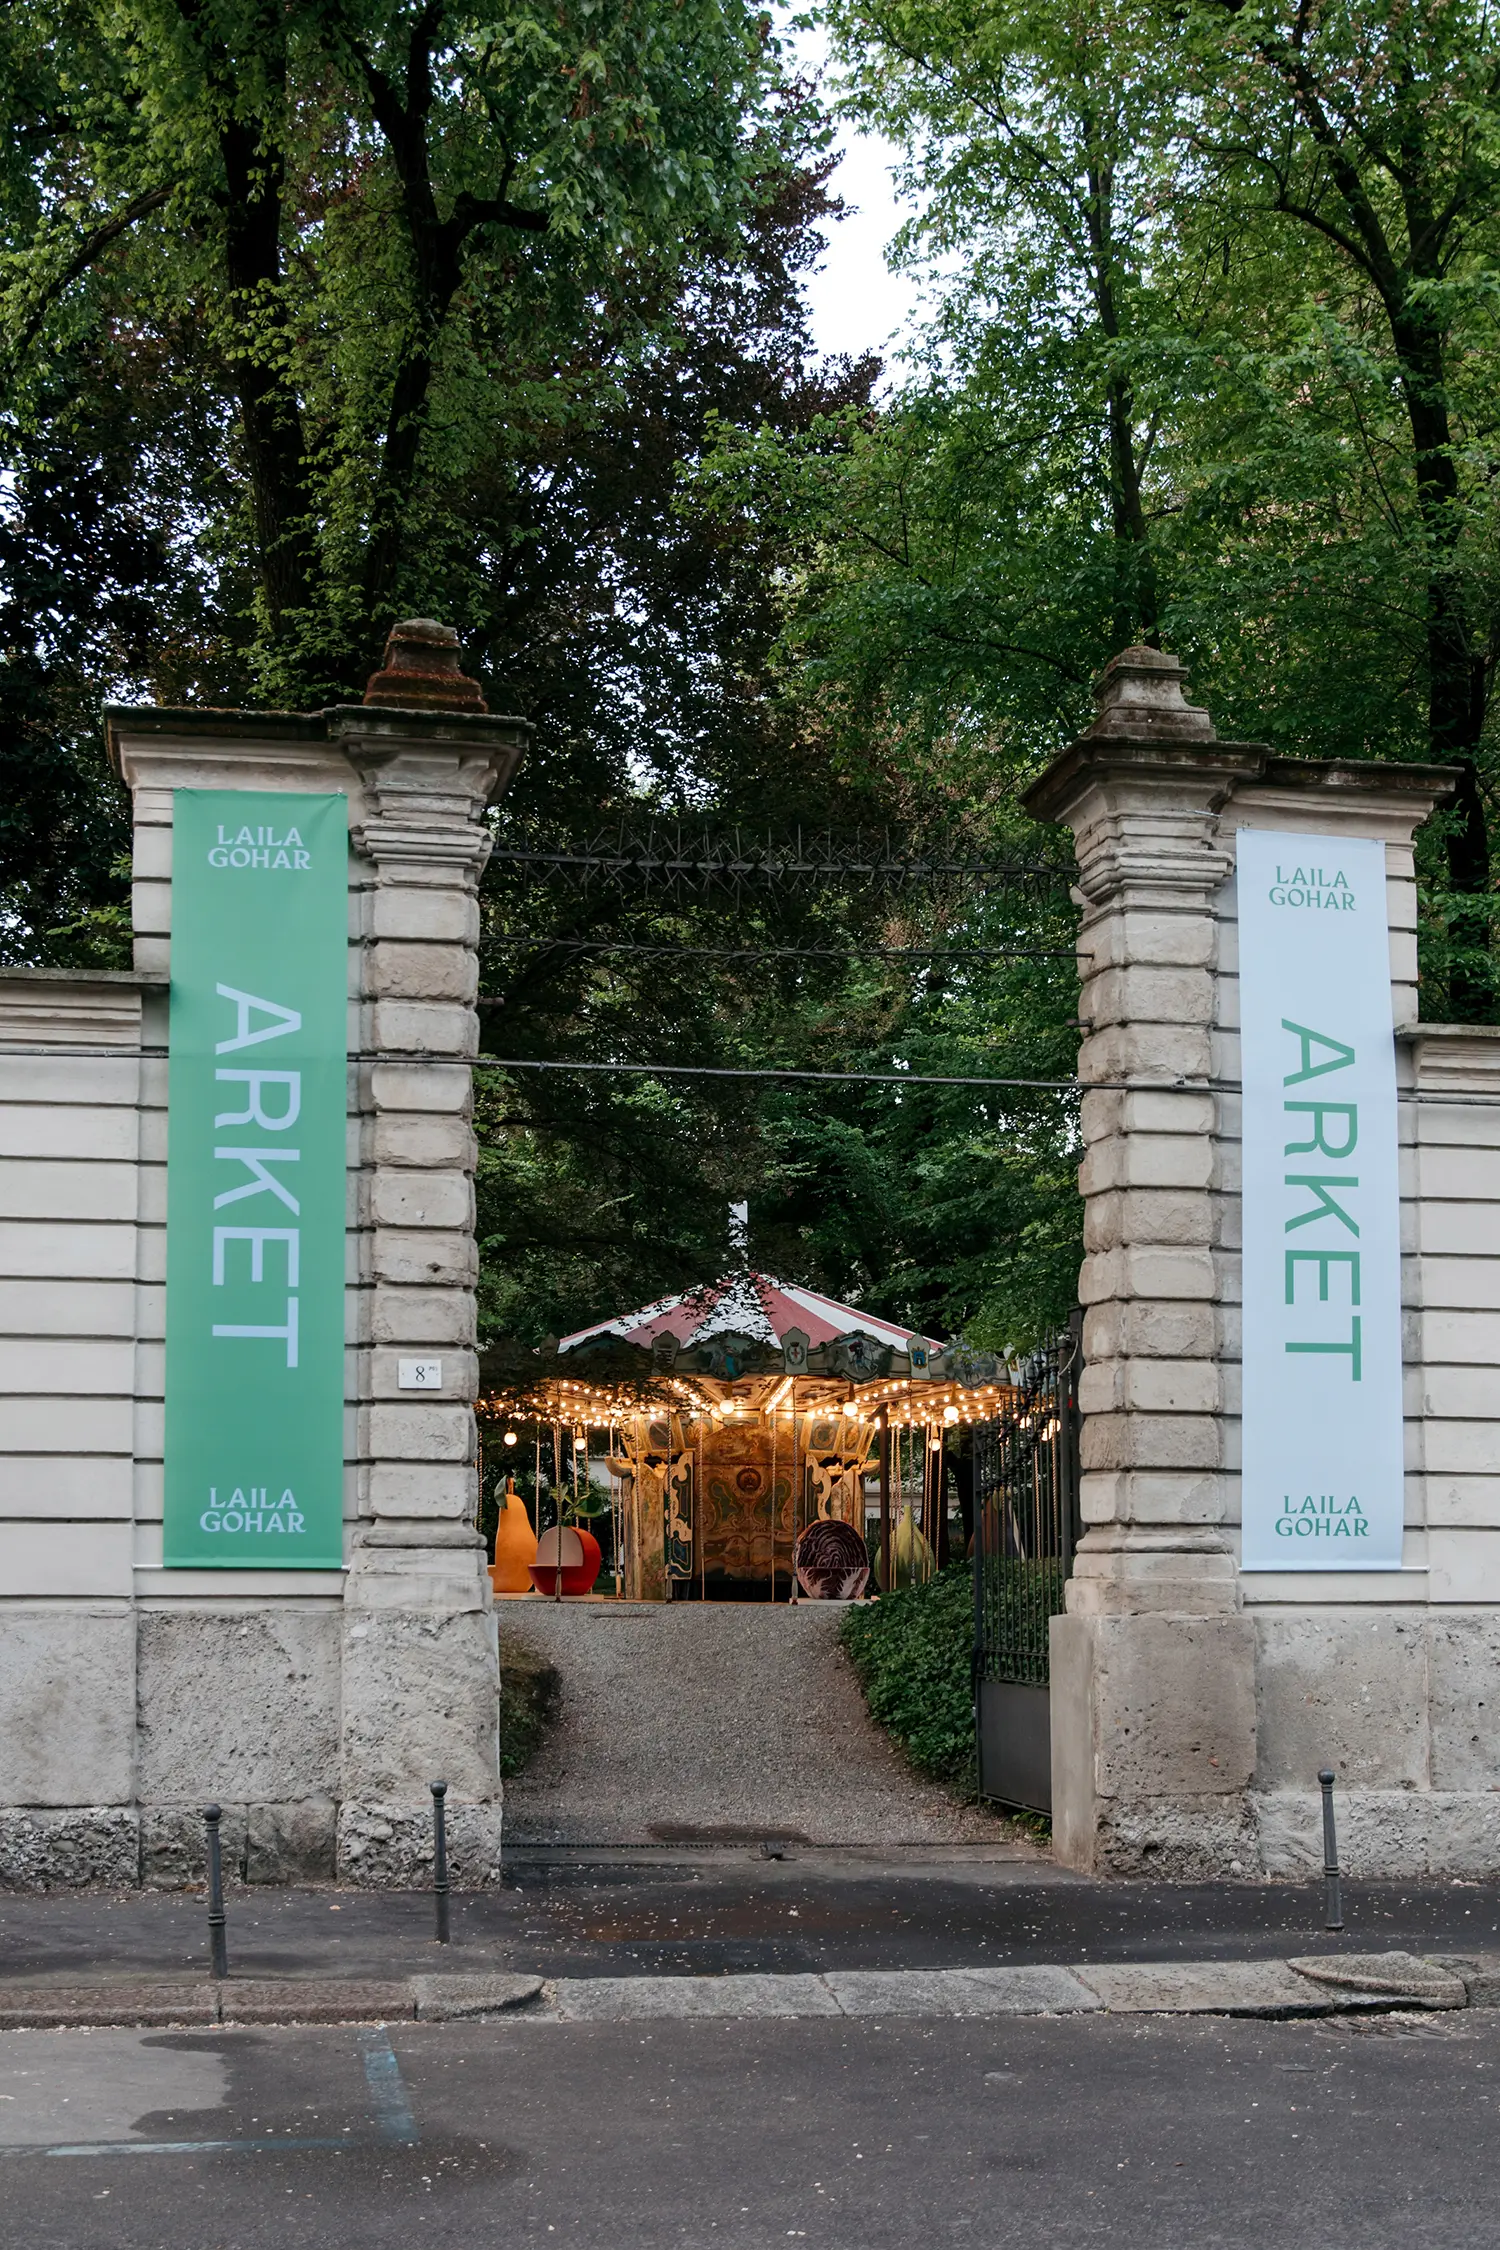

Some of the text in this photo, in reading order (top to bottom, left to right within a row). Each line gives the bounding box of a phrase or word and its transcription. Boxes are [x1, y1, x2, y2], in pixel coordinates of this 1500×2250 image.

[217, 825, 304, 847] LAILA
[208, 847, 312, 870] GOHAR
[1275, 865, 1349, 889] LAILA
[1268, 886, 1356, 912] GOHAR
[213, 982, 302, 1368] ARKET
[1281, 1017, 1362, 1382] ARKET
[415, 1365, 426, 1383] 8
[209, 1487, 298, 1509] LAILA
[1283, 1495, 1364, 1515] LAILA
[199, 1511, 307, 1533] GOHAR
[1274, 1517, 1370, 1537] GOHAR
